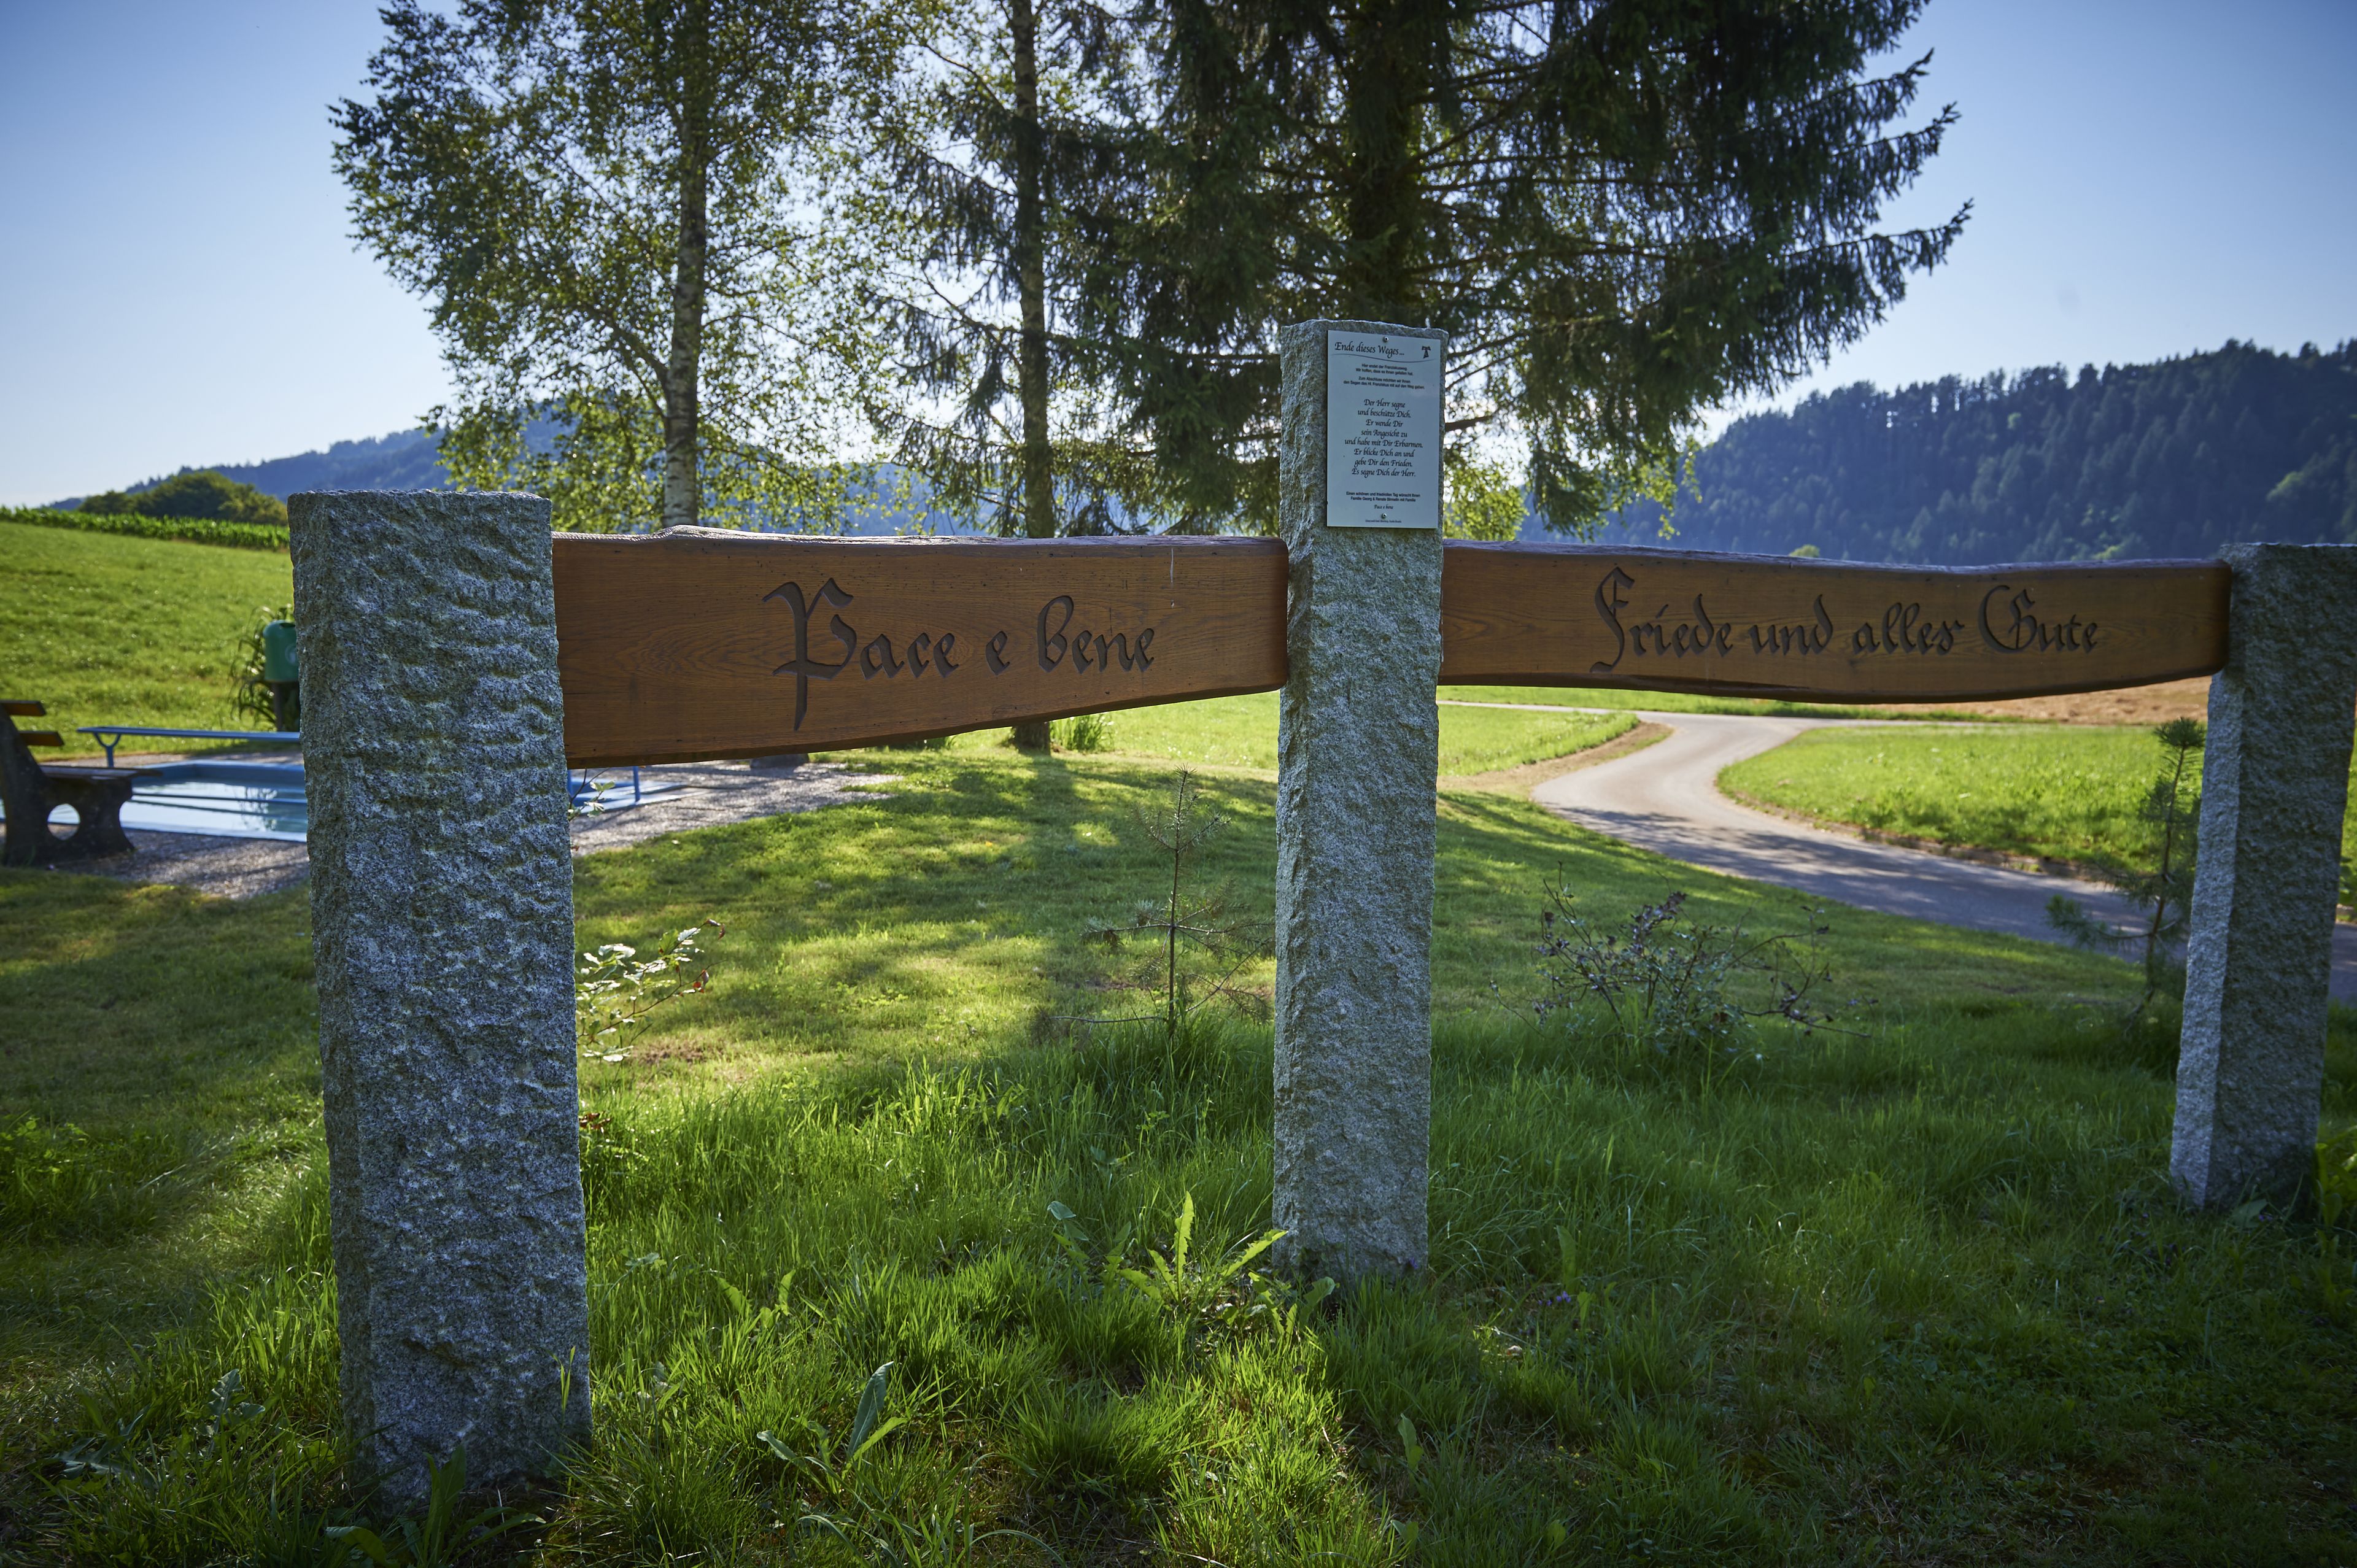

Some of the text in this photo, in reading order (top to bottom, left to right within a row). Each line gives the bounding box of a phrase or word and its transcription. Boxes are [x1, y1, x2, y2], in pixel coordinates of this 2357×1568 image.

[1335, 341, 1354, 351] Ende
[1357, 342, 1376, 353] dieses
[1376, 398, 1390, 407] Herr
[1371, 408, 1395, 417] beschütze
[1373, 430, 1399, 439] Angesicht
[1394, 439, 1423, 448] Erbarmen.
[1354, 457, 1367, 468] gebe
[1590, 566, 2099, 673] Friede und alles Gute
[762, 576, 1155, 731] Pace e bene
